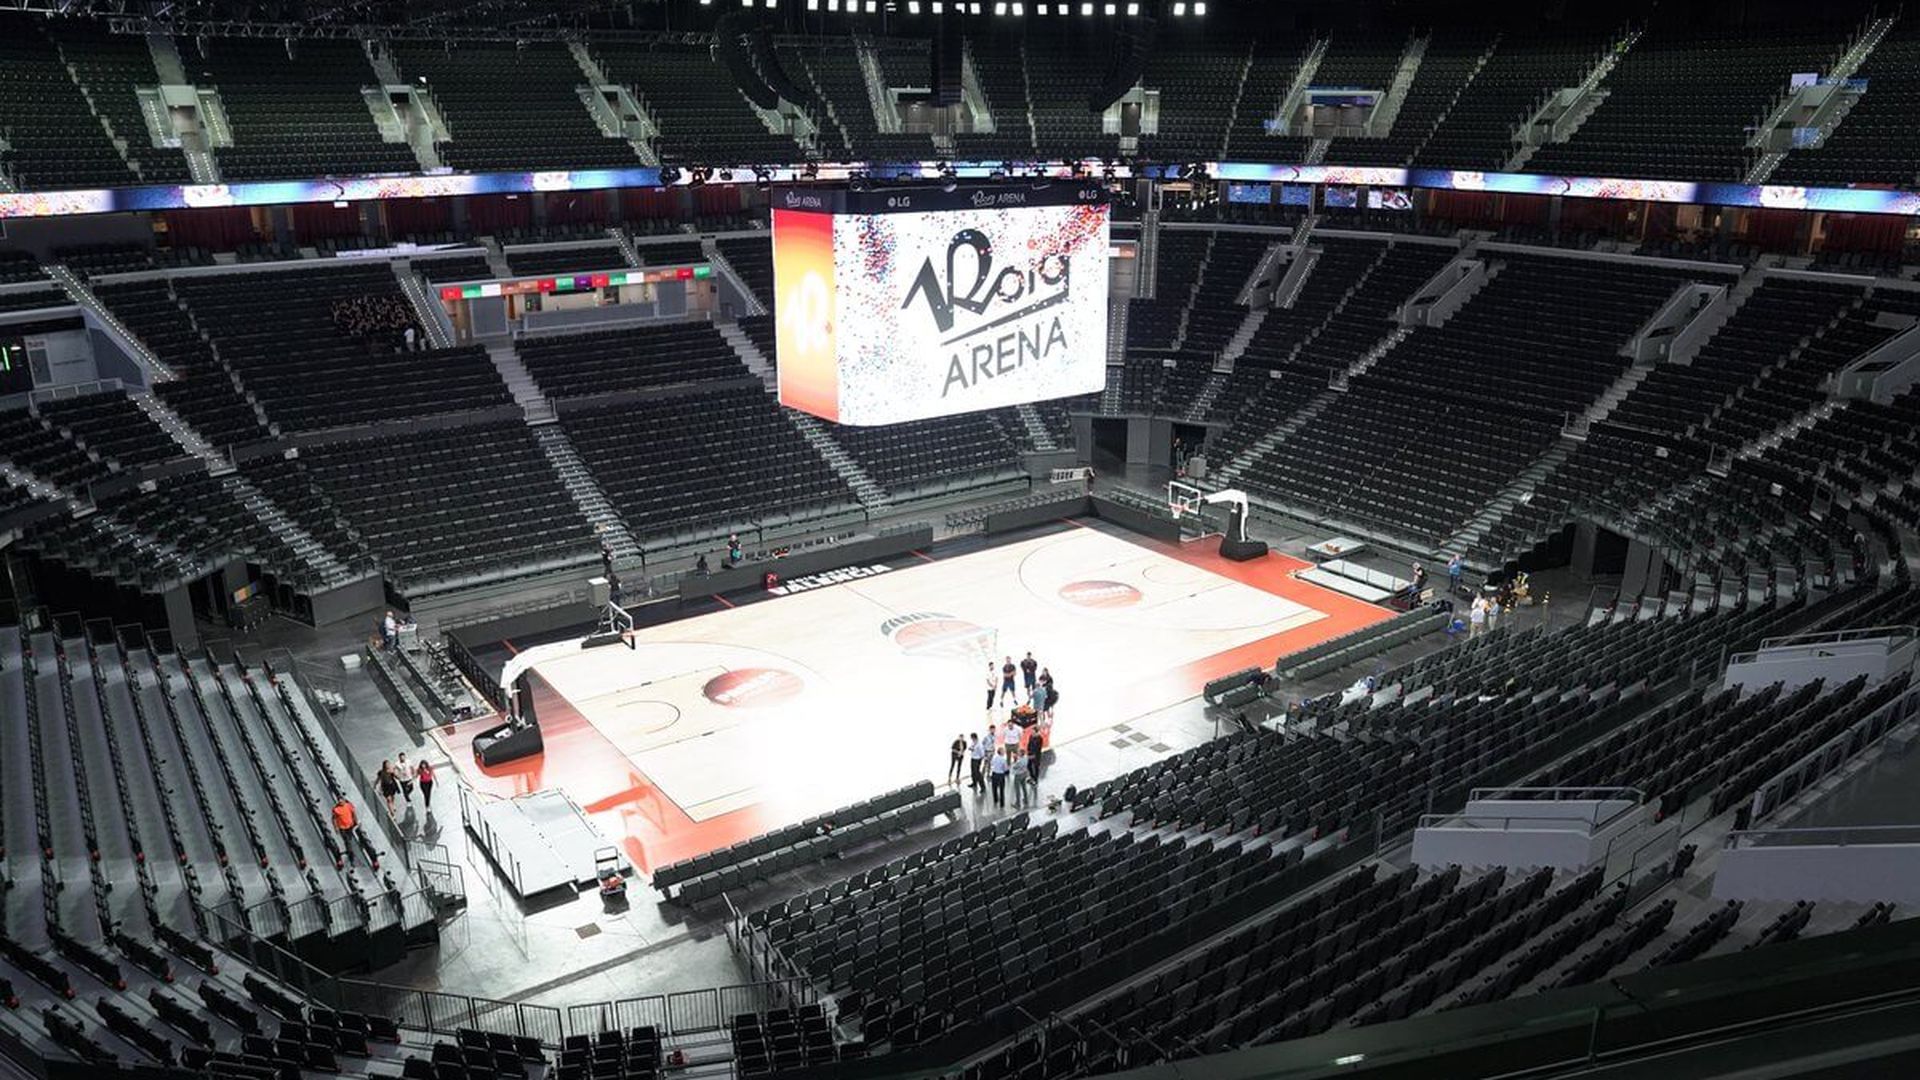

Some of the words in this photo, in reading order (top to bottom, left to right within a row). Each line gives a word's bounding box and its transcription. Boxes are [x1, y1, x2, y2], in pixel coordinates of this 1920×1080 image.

[997, 193, 1026, 204] ARENA
[1086, 190, 1098, 200] LG
[802, 197, 821, 207] ARENA
[897, 197, 911, 207] LG
[901, 228, 1071, 345] Roig
[941, 316, 1068, 398] ARENA
